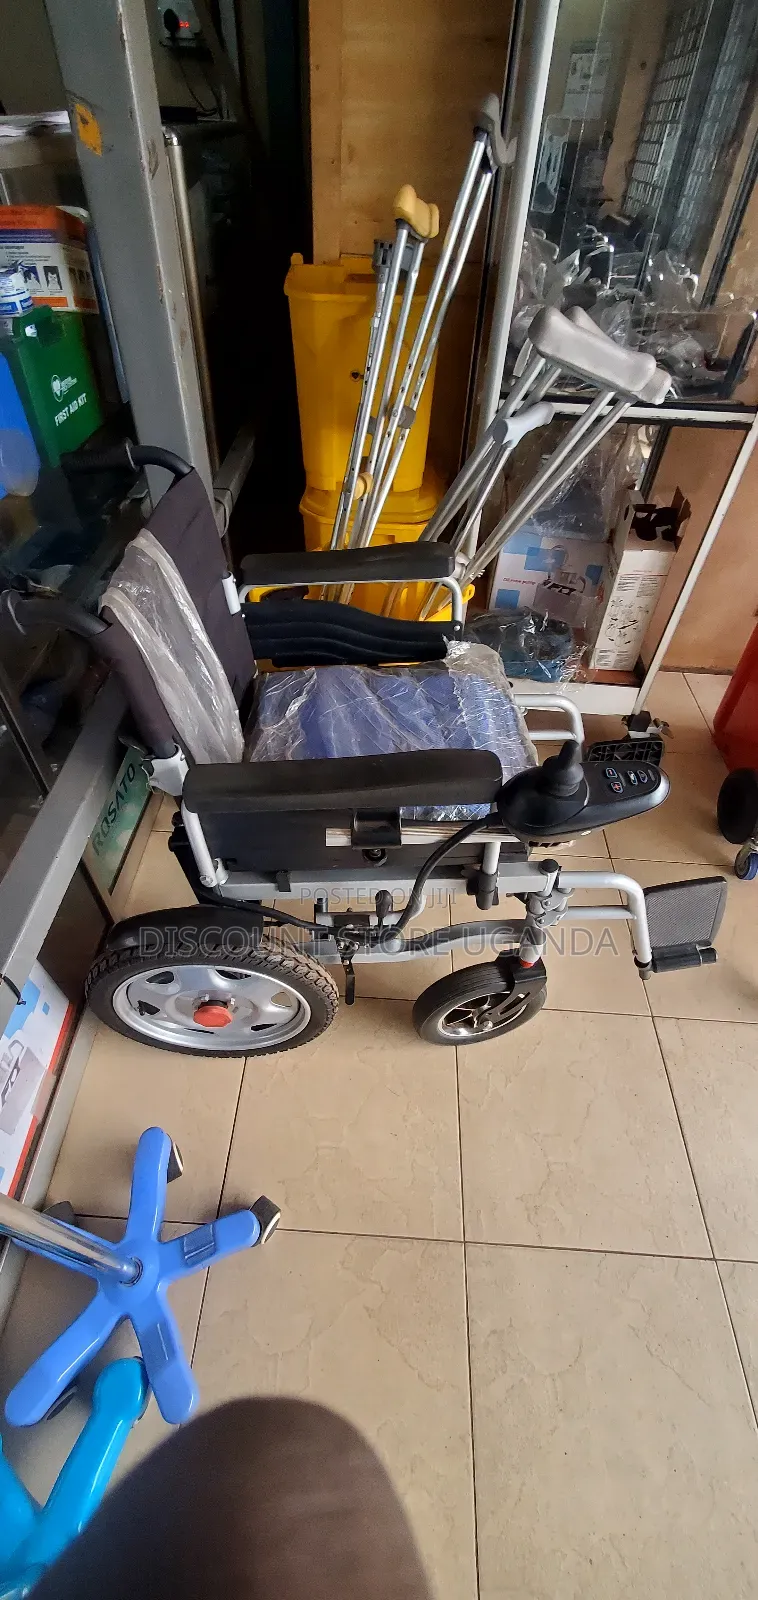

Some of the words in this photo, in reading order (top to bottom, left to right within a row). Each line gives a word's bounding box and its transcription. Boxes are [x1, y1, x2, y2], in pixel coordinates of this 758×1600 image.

[54, 407, 70, 427] FIRST
[69, 400, 79, 415] AID
[77, 393, 88, 407] KIT
[91, 763, 136, 856] ROSATO
